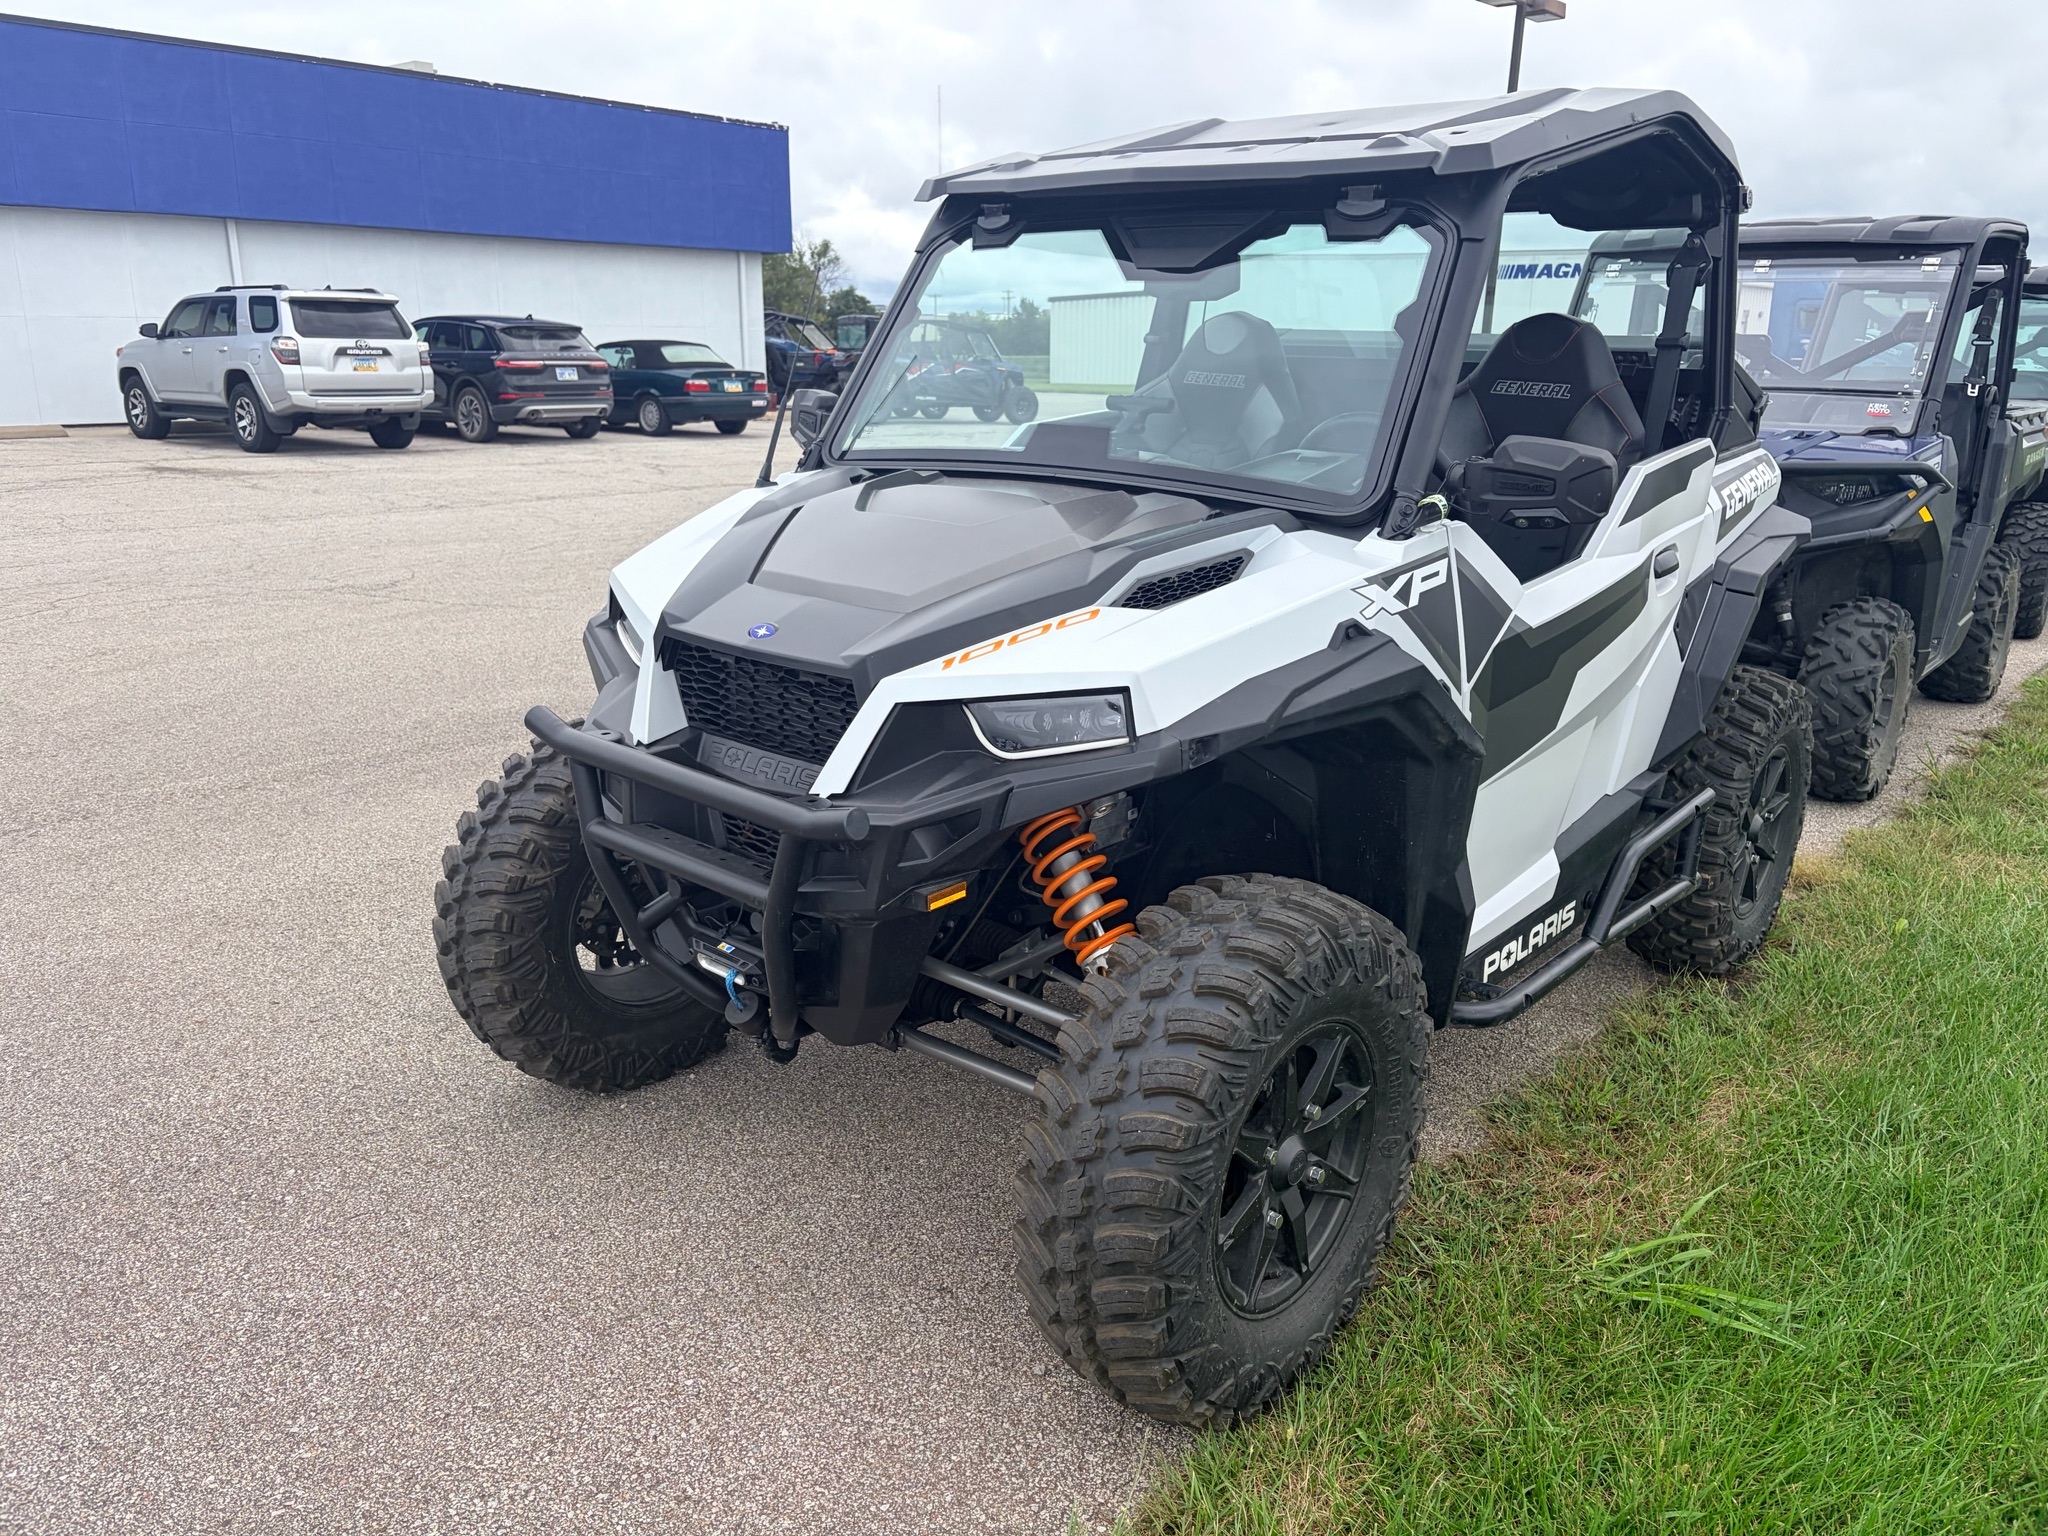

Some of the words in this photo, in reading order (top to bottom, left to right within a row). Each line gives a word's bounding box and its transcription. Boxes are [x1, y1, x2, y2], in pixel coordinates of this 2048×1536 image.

[1184, 371, 1245, 388] GENERAL
[1491, 380, 1571, 399] GENERAL
[1720, 462, 1777, 520] GENERAL
[1350, 557, 1449, 620] XP
[941, 608, 1101, 671] 1000
[709, 741, 820, 792] POLARIS
[1483, 900, 1577, 984] POLARIS
